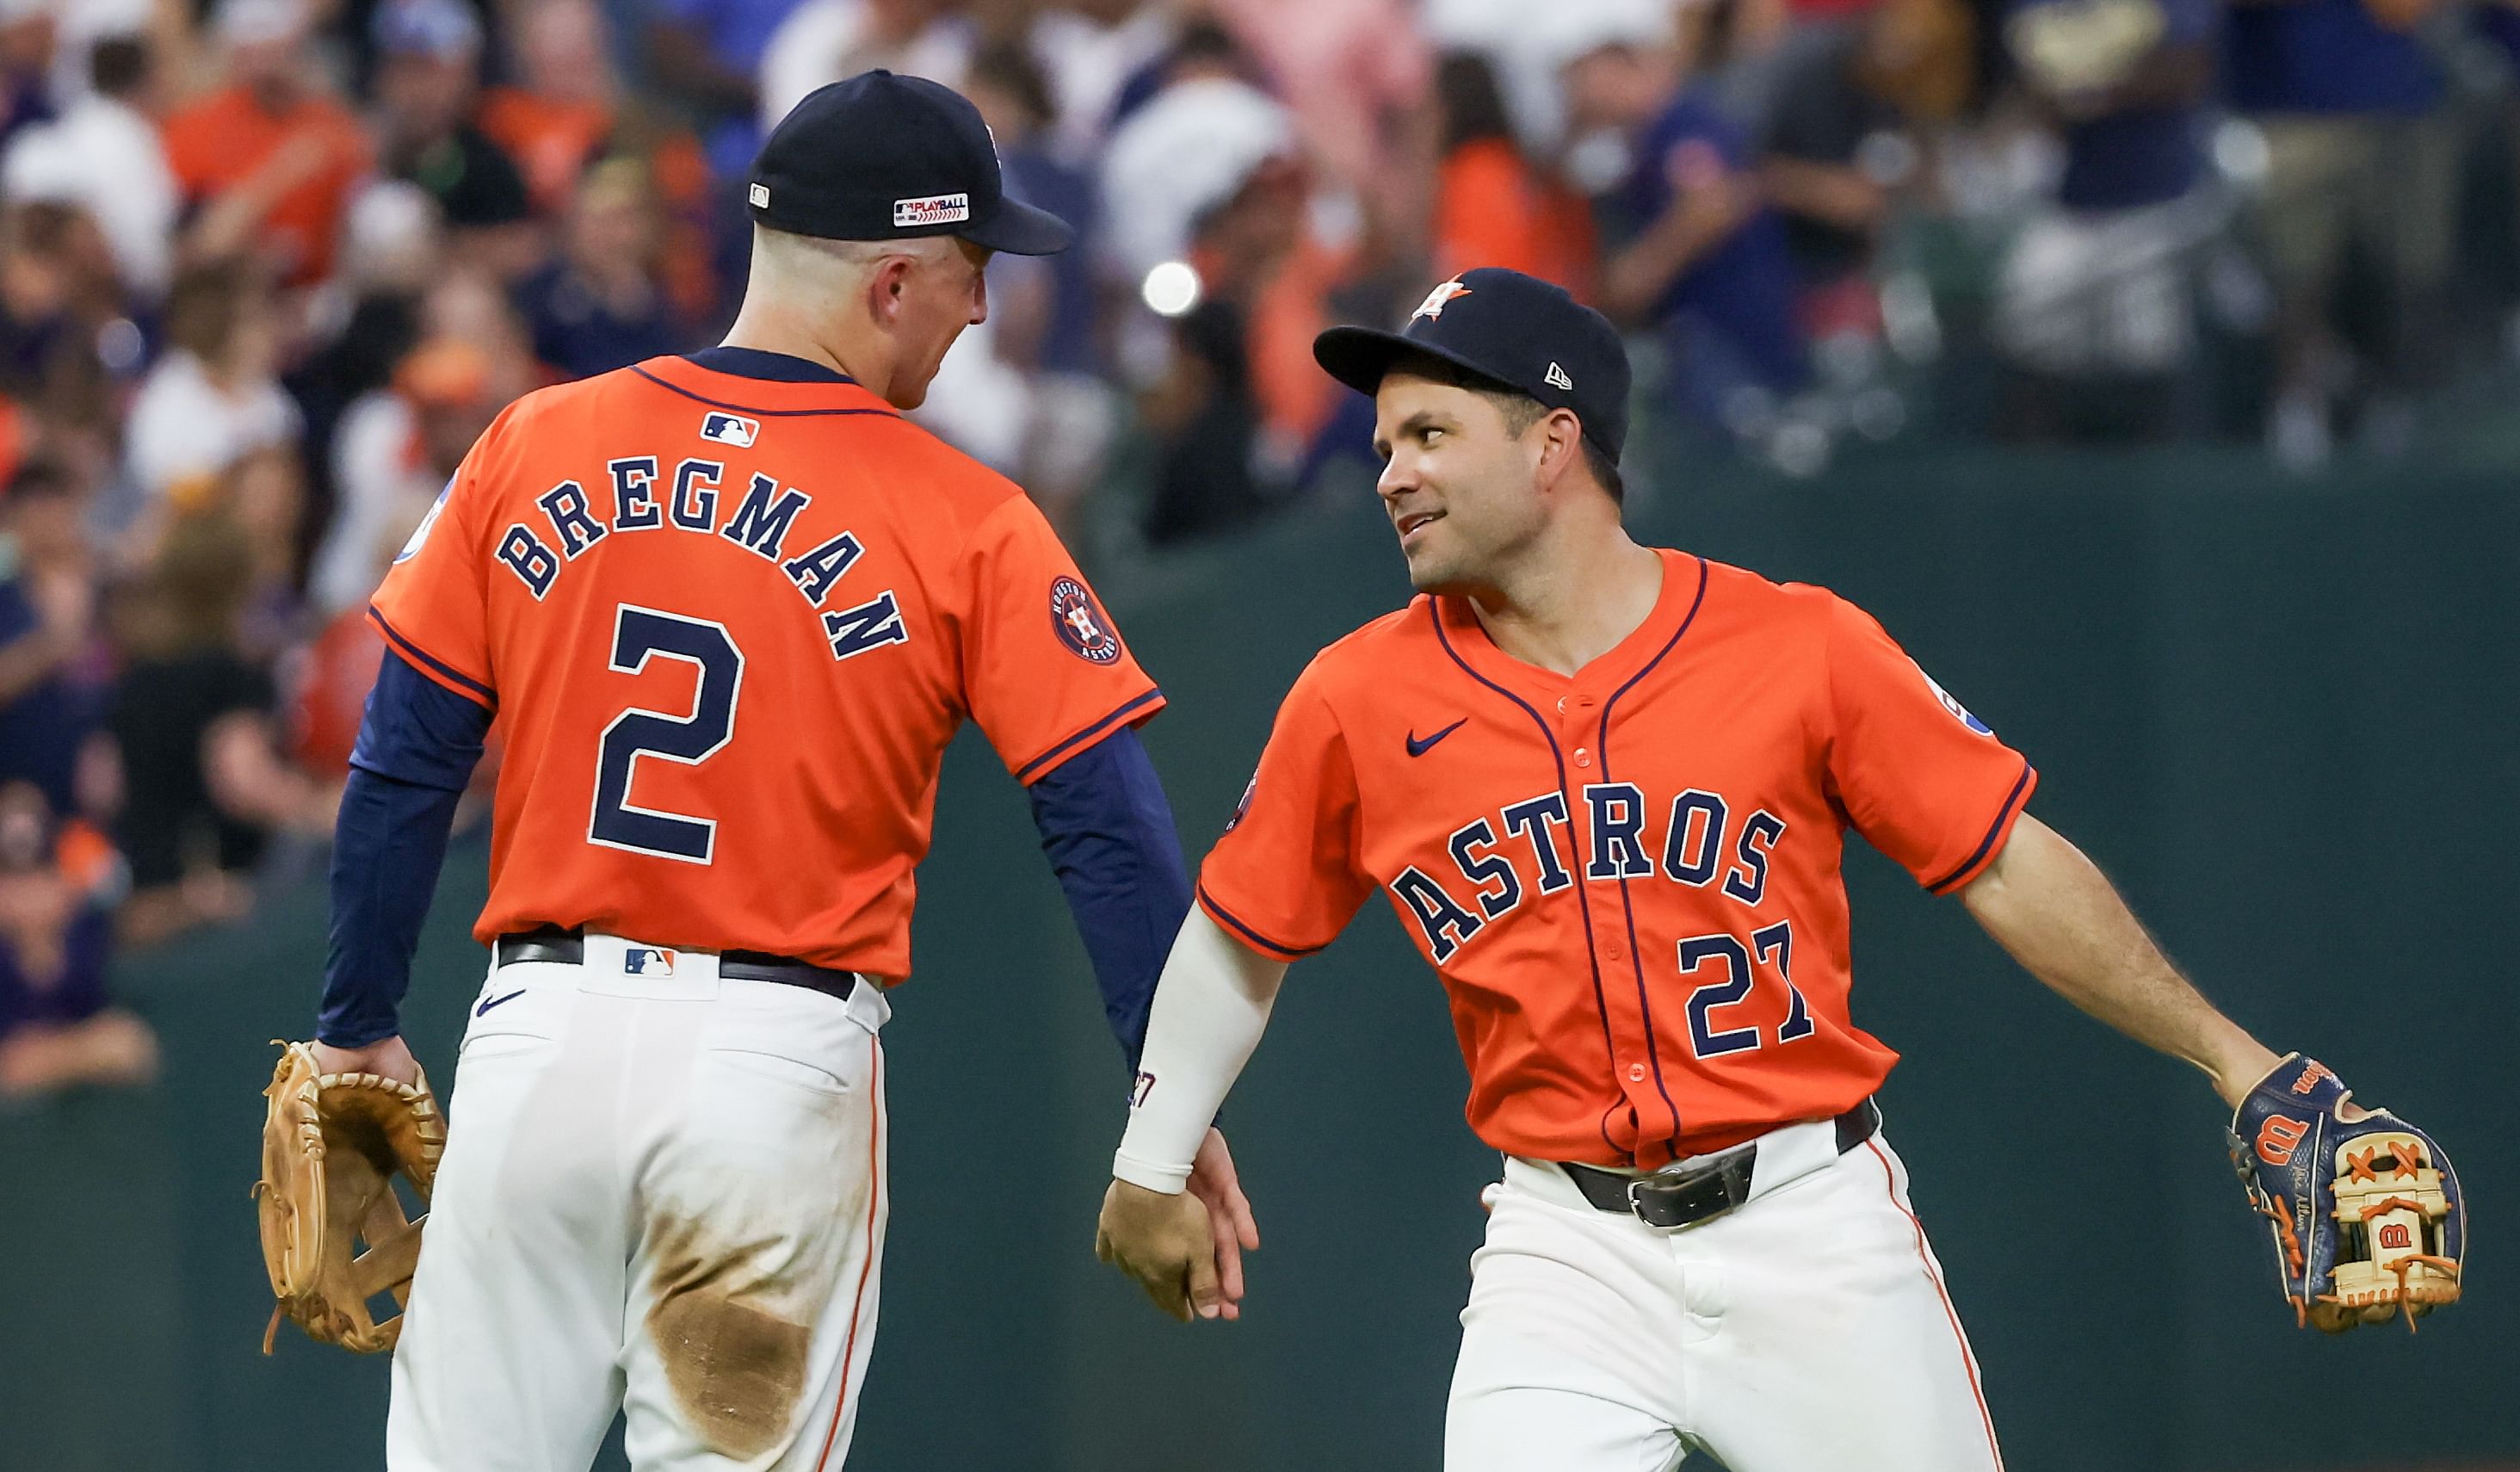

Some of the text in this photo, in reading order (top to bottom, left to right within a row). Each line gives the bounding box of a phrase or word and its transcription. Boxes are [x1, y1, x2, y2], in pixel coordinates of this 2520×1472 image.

[494, 455, 910, 661] BREGMAN
[1053, 582, 1086, 615] HOUSTON
[1083, 635, 1115, 659] ASTROS
[586, 602, 745, 866] 2
[1389, 782, 1787, 966] ASTROS
[1677, 918, 1815, 1060] 27
